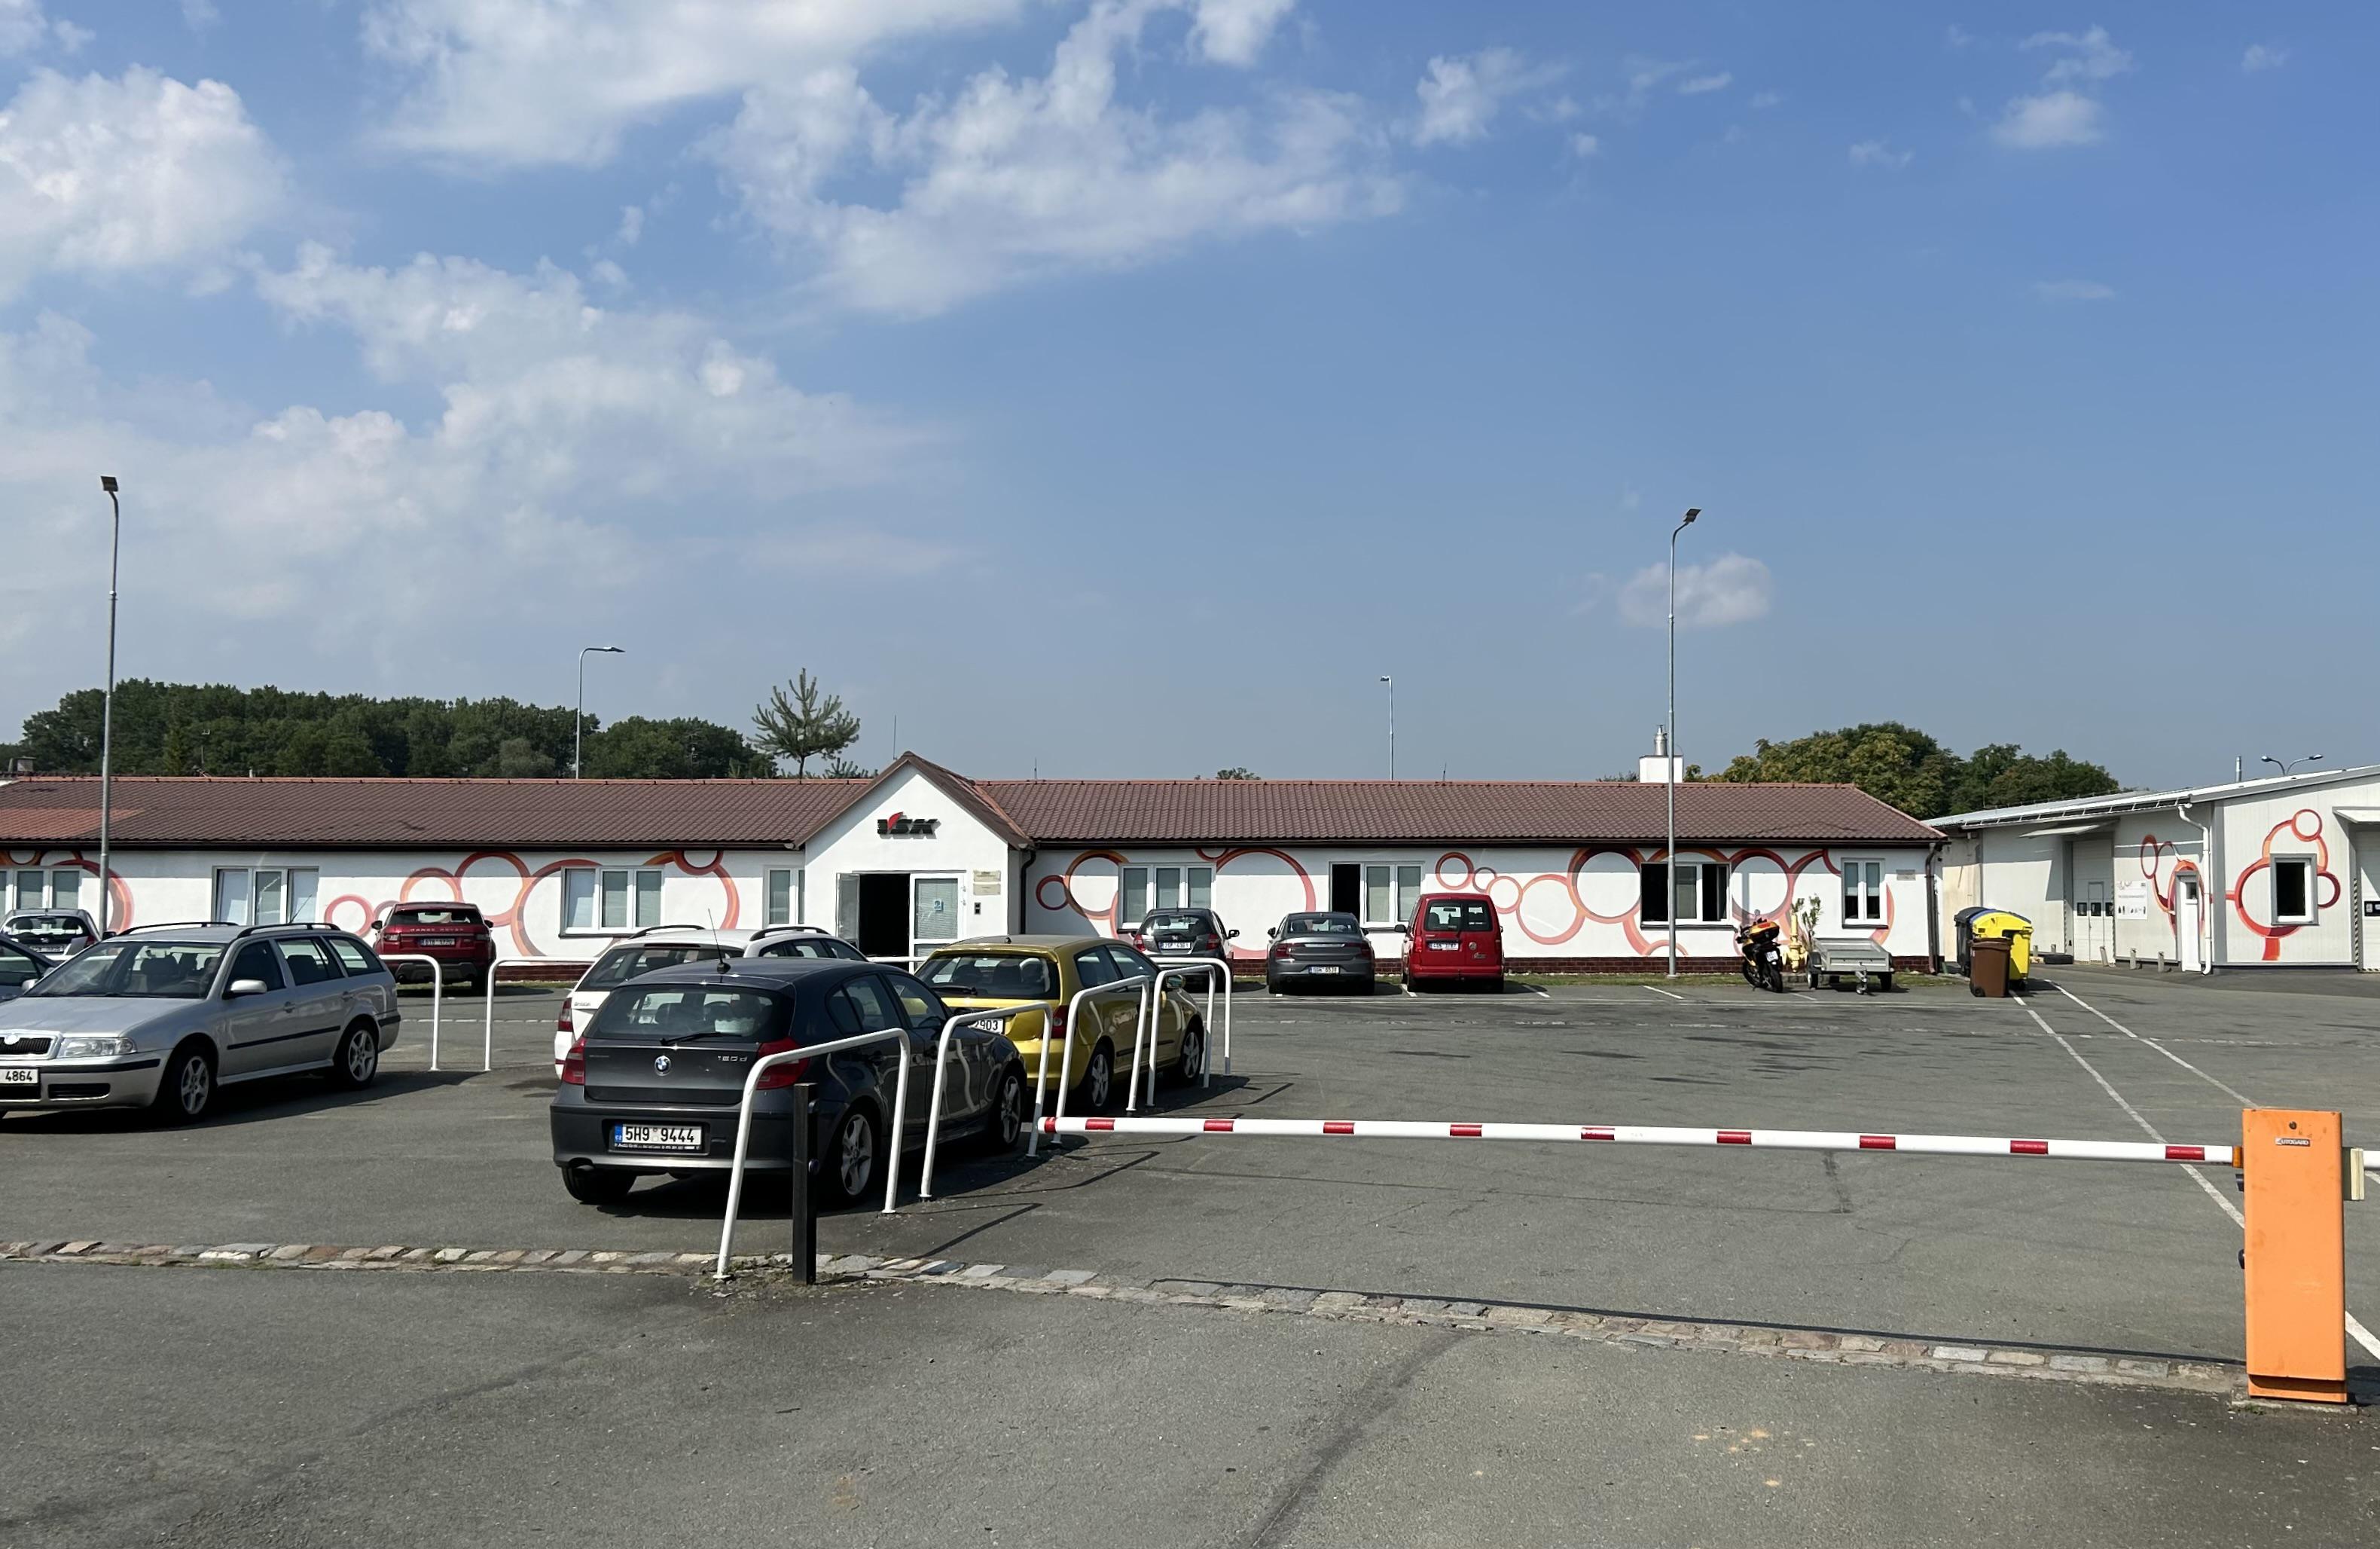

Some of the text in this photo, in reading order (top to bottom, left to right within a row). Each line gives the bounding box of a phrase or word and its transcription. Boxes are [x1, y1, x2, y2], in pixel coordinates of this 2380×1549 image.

[5, 1070, 33, 1082] 4864
[624, 1126, 694, 1143] 5H9 9444
